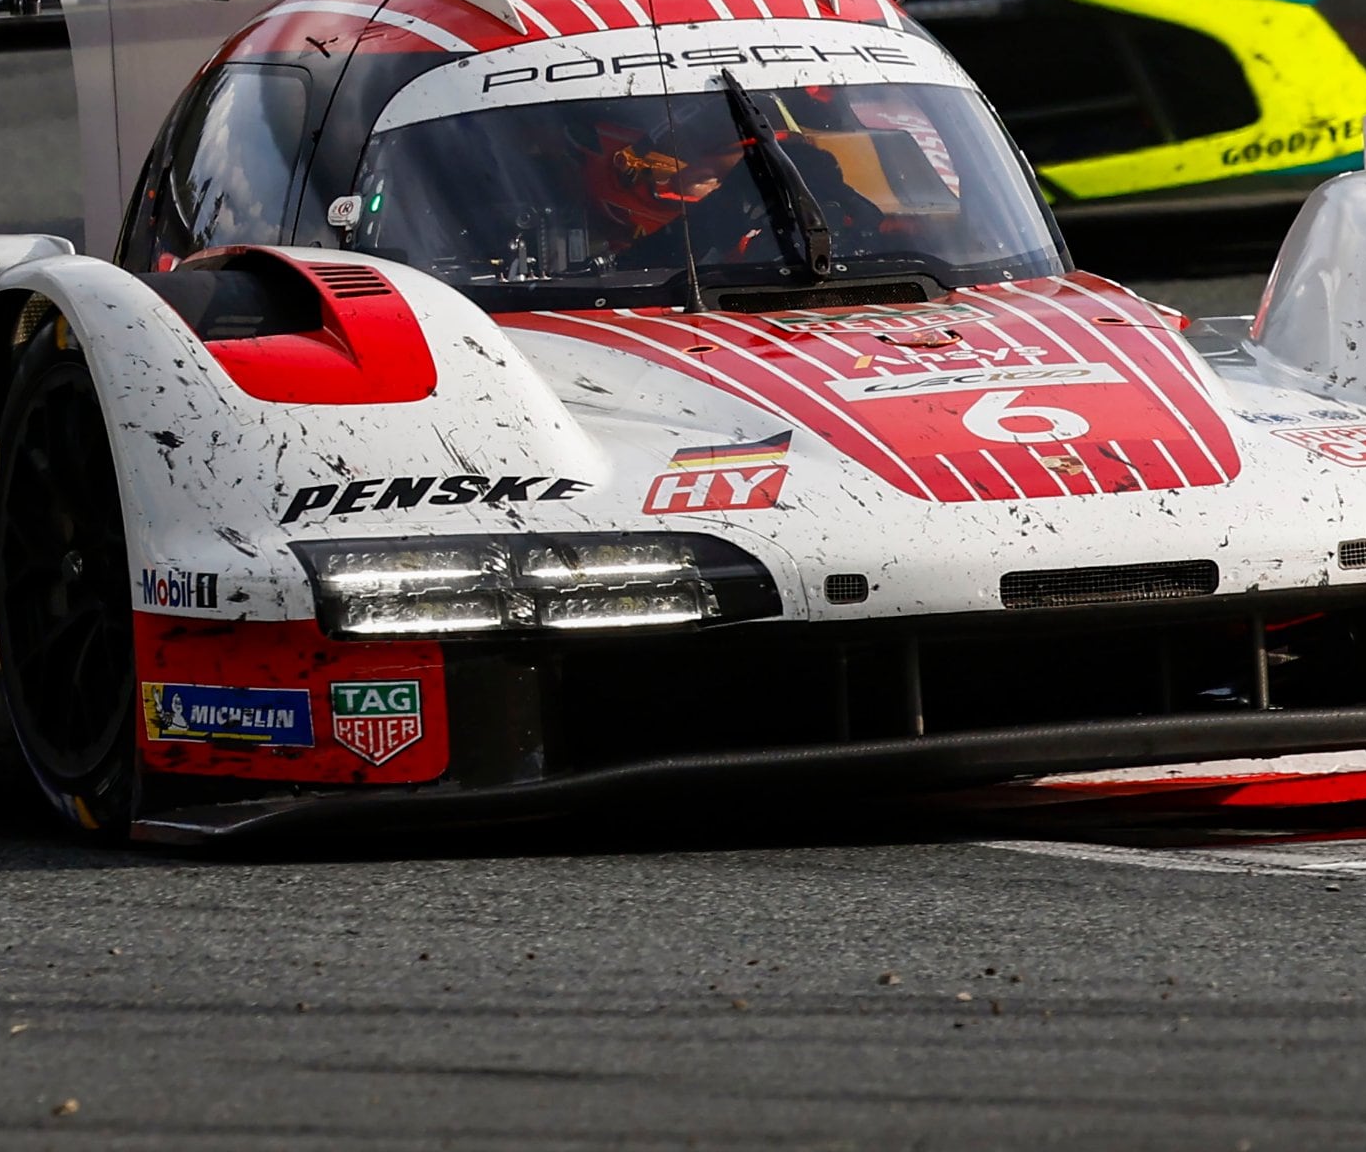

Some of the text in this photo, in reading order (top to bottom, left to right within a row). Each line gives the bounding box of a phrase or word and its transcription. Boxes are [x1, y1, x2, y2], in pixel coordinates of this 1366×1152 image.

[482, 45, 916, 93] PORSCHE
[853, 346, 1049, 369] Ansys
[962, 390, 1090, 443] 6
[279, 475, 594, 526] PENSKE
[648, 471, 772, 510] HY
[143, 569, 215, 608] Mobil 1
[191, 705, 294, 728] MICHELIN
[338, 688, 411, 712] TAG
[339, 719, 414, 757] HEUER
